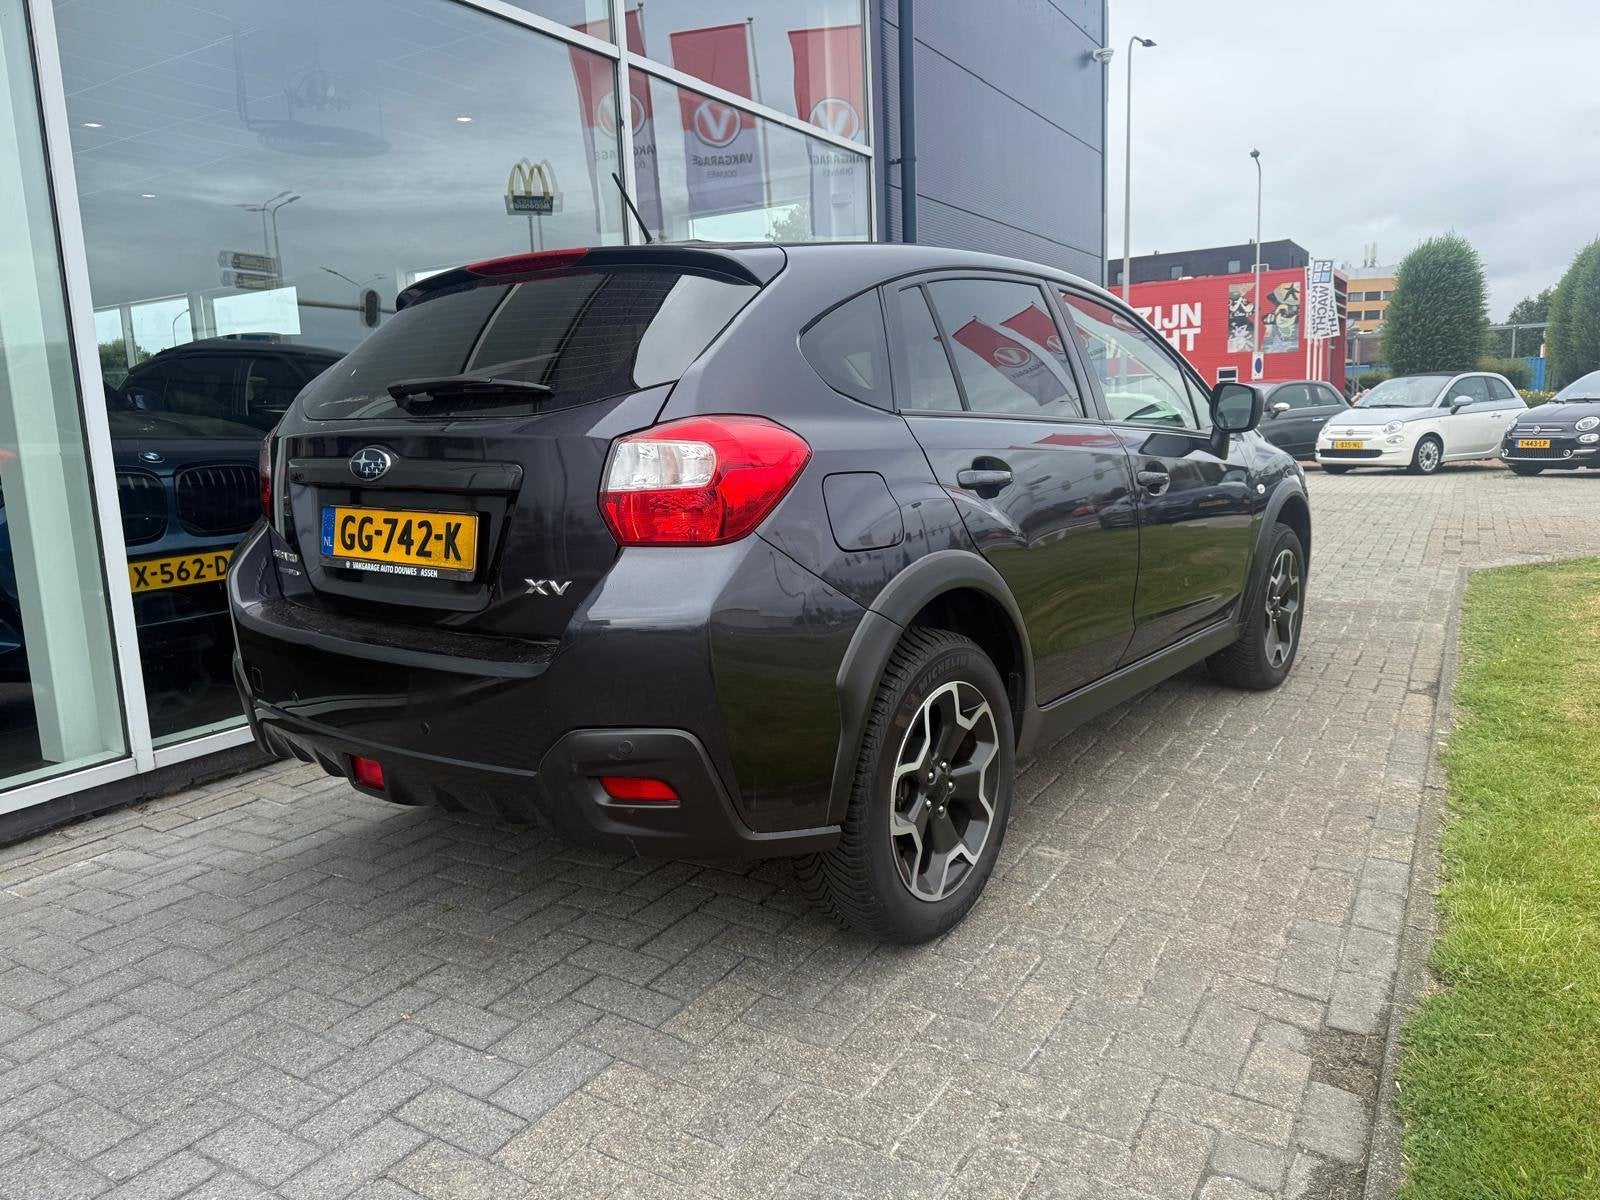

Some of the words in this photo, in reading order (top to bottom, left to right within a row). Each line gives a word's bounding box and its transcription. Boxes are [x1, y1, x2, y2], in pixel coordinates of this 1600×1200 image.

[323, 536, 333, 547] NL
[341, 515, 462, 561] GG-742-K
[133, 555, 228, 587] X-562-D
[352, 561, 380, 572] VAKGARAGE
[380, 564, 394, 573] AUTO
[394, 565, 417, 576] DOUWES
[421, 568, 438, 578] ASSEN
[523, 578, 573, 596] XV
